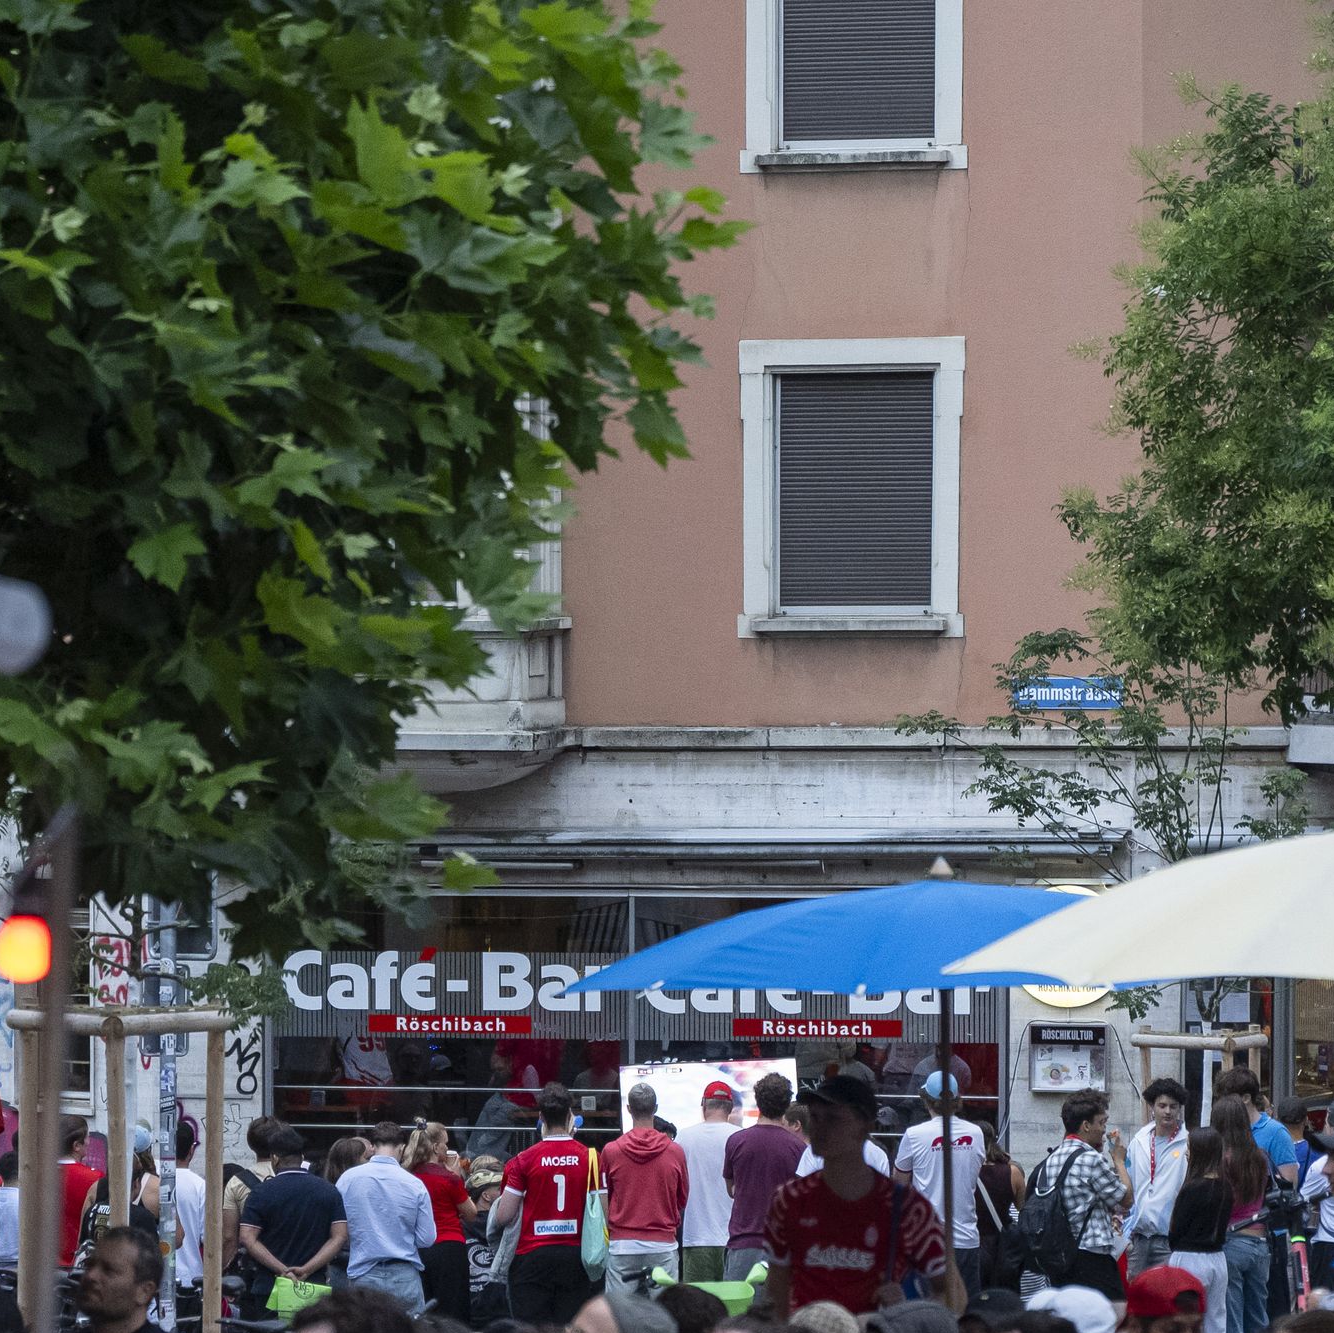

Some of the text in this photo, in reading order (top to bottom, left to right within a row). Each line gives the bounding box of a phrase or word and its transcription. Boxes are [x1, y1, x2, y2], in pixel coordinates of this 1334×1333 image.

[283, 947, 609, 1011] Café-Bar
[396, 1016, 506, 1032] Röschibach
[762, 1020, 873, 1036] Röschibach
[1041, 1028, 1094, 1040] RÖSCHIKULTUR
[541, 1155, 579, 1166] MOSER
[553, 1173, 566, 1212] 1
[536, 1223, 575, 1233] CONCORDIA
